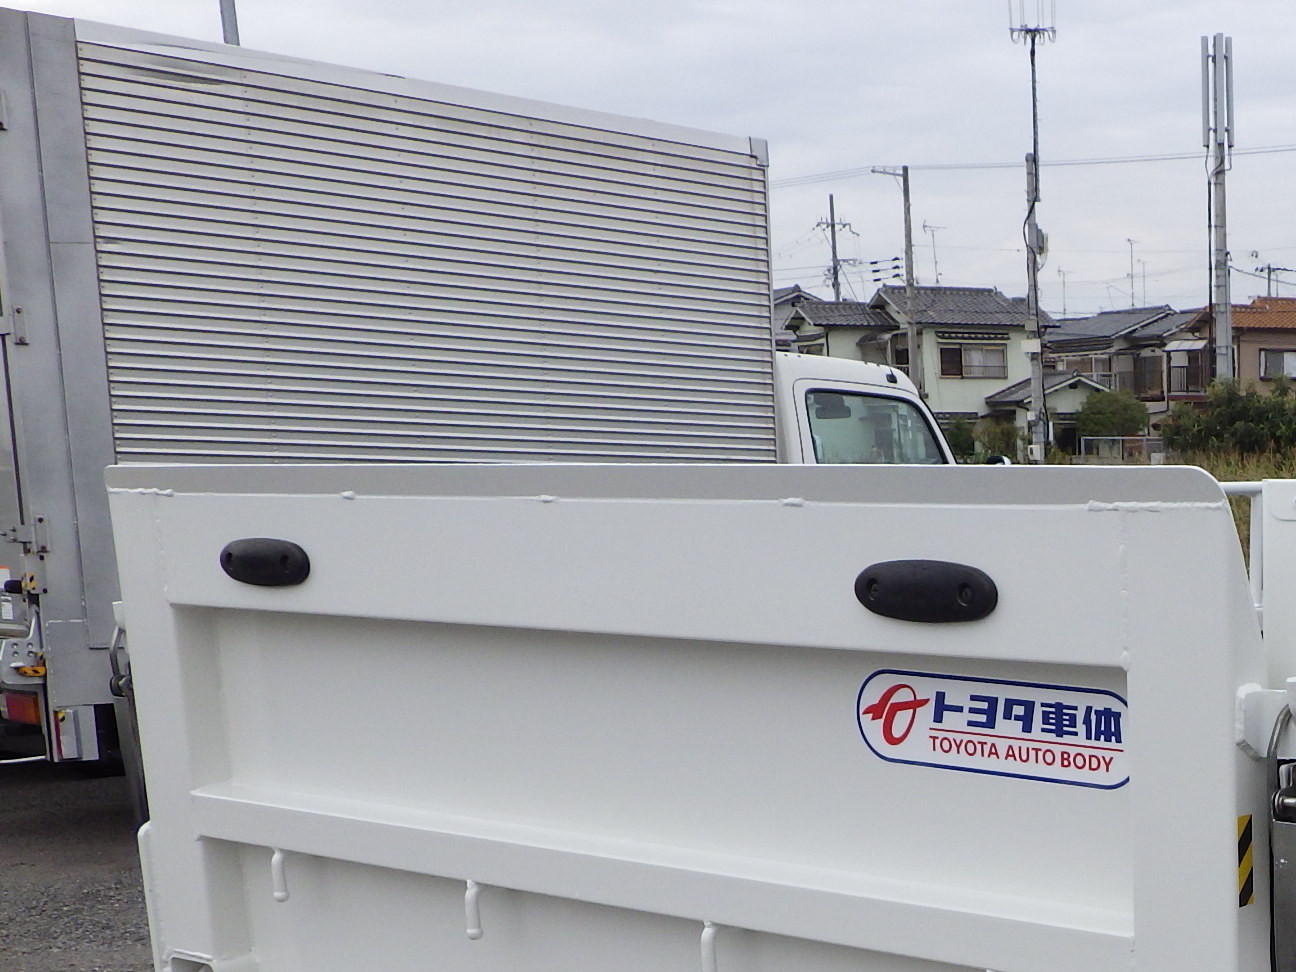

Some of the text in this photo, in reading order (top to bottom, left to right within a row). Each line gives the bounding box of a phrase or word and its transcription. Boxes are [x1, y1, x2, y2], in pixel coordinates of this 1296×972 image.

[931, 690, 1123, 744] トヨタ車体
[928, 735, 1115, 773] TOYOTA AUTO BODY
